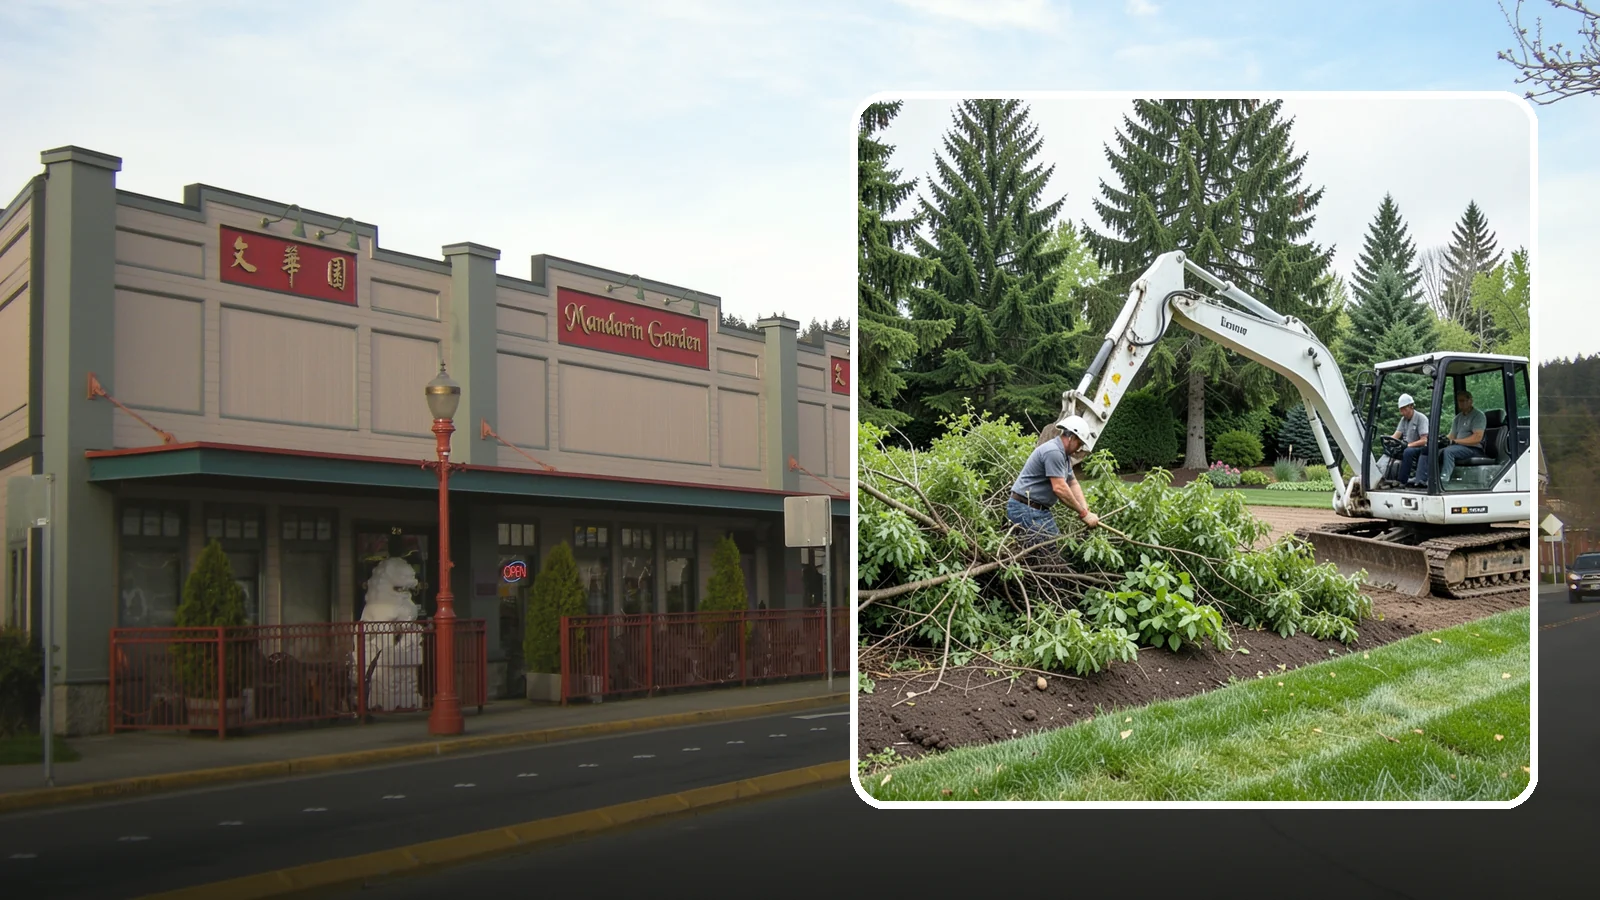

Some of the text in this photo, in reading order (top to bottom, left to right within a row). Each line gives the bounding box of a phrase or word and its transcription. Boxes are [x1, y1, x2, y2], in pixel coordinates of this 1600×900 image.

[231, 236, 346, 291] 文華園
[565, 303, 702, 352] Mandarin Garden
[834, 362, 847, 386] 文
[503, 565, 527, 578] OPEN
